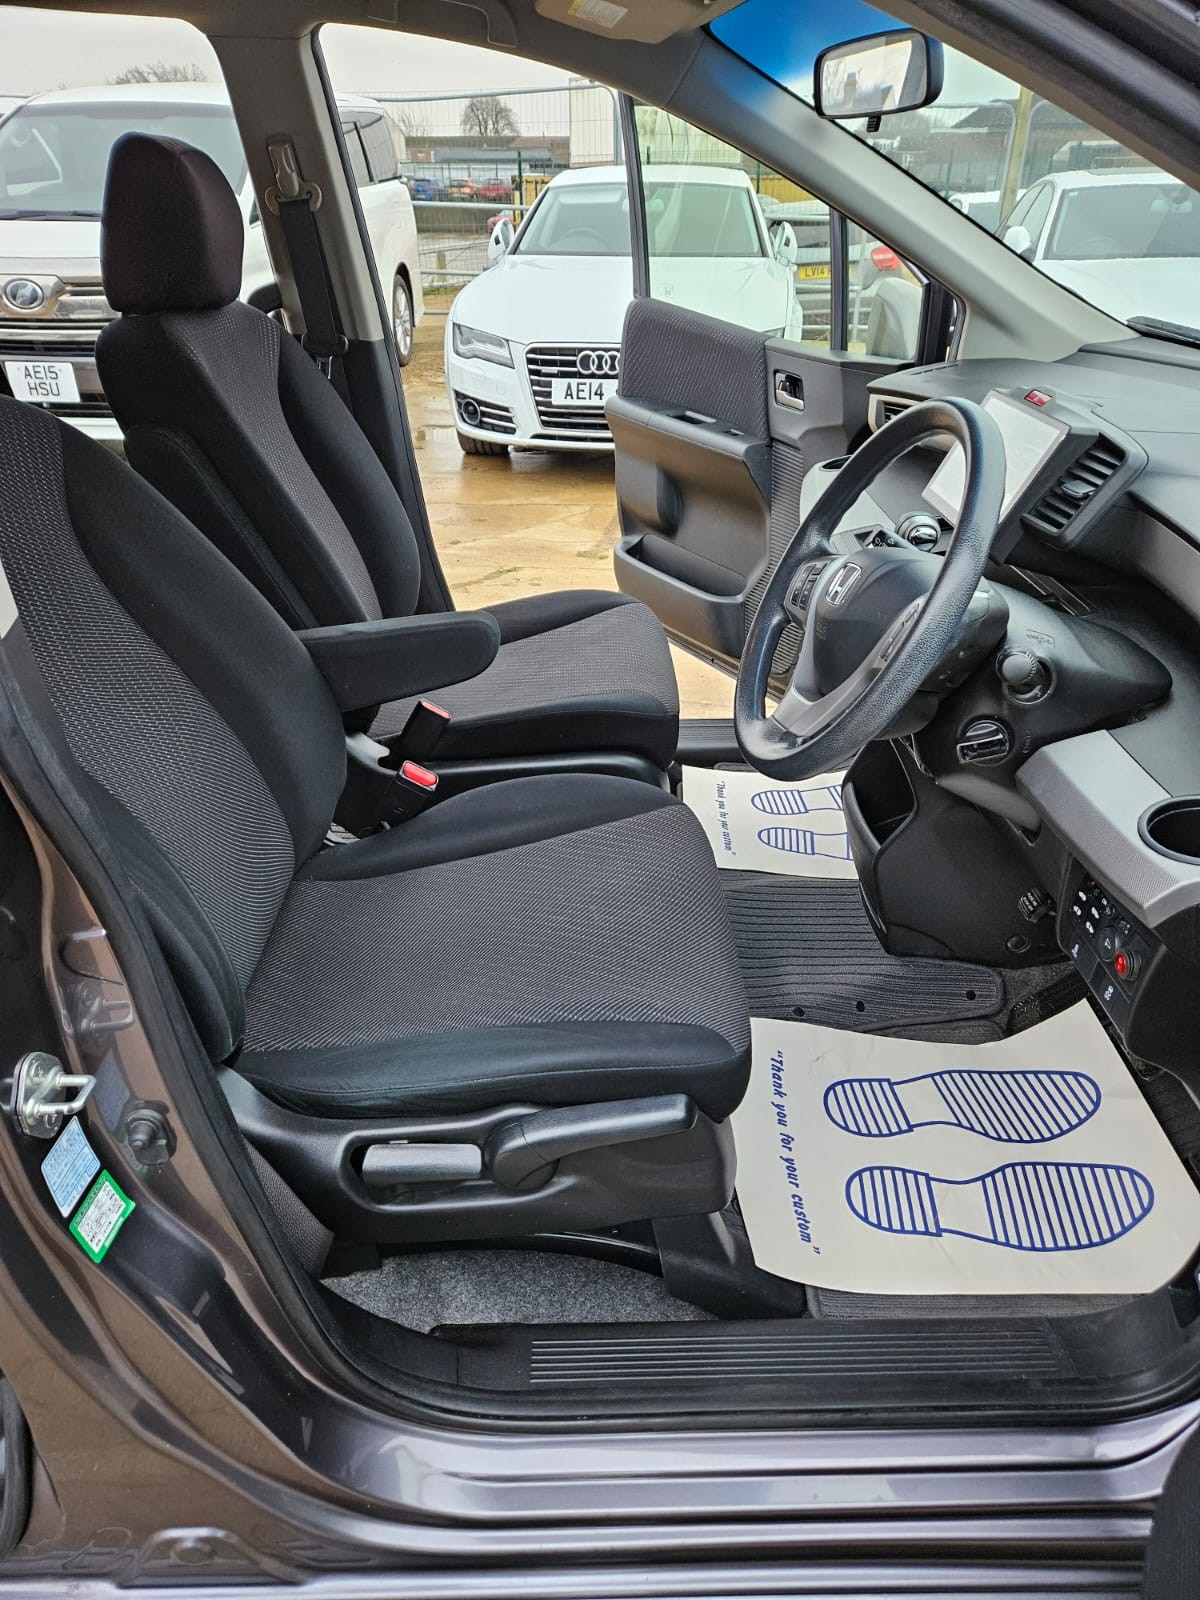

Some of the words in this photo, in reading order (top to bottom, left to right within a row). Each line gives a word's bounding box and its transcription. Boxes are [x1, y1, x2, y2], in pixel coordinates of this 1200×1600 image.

[24, 365, 59, 380] AE15
[27, 381, 61, 396] HSU
[564, 381, 605, 400] AE14
[771, 1101, 788, 1127] you
[779, 1132, 795, 1152] for
[779, 1155, 800, 1188] your
